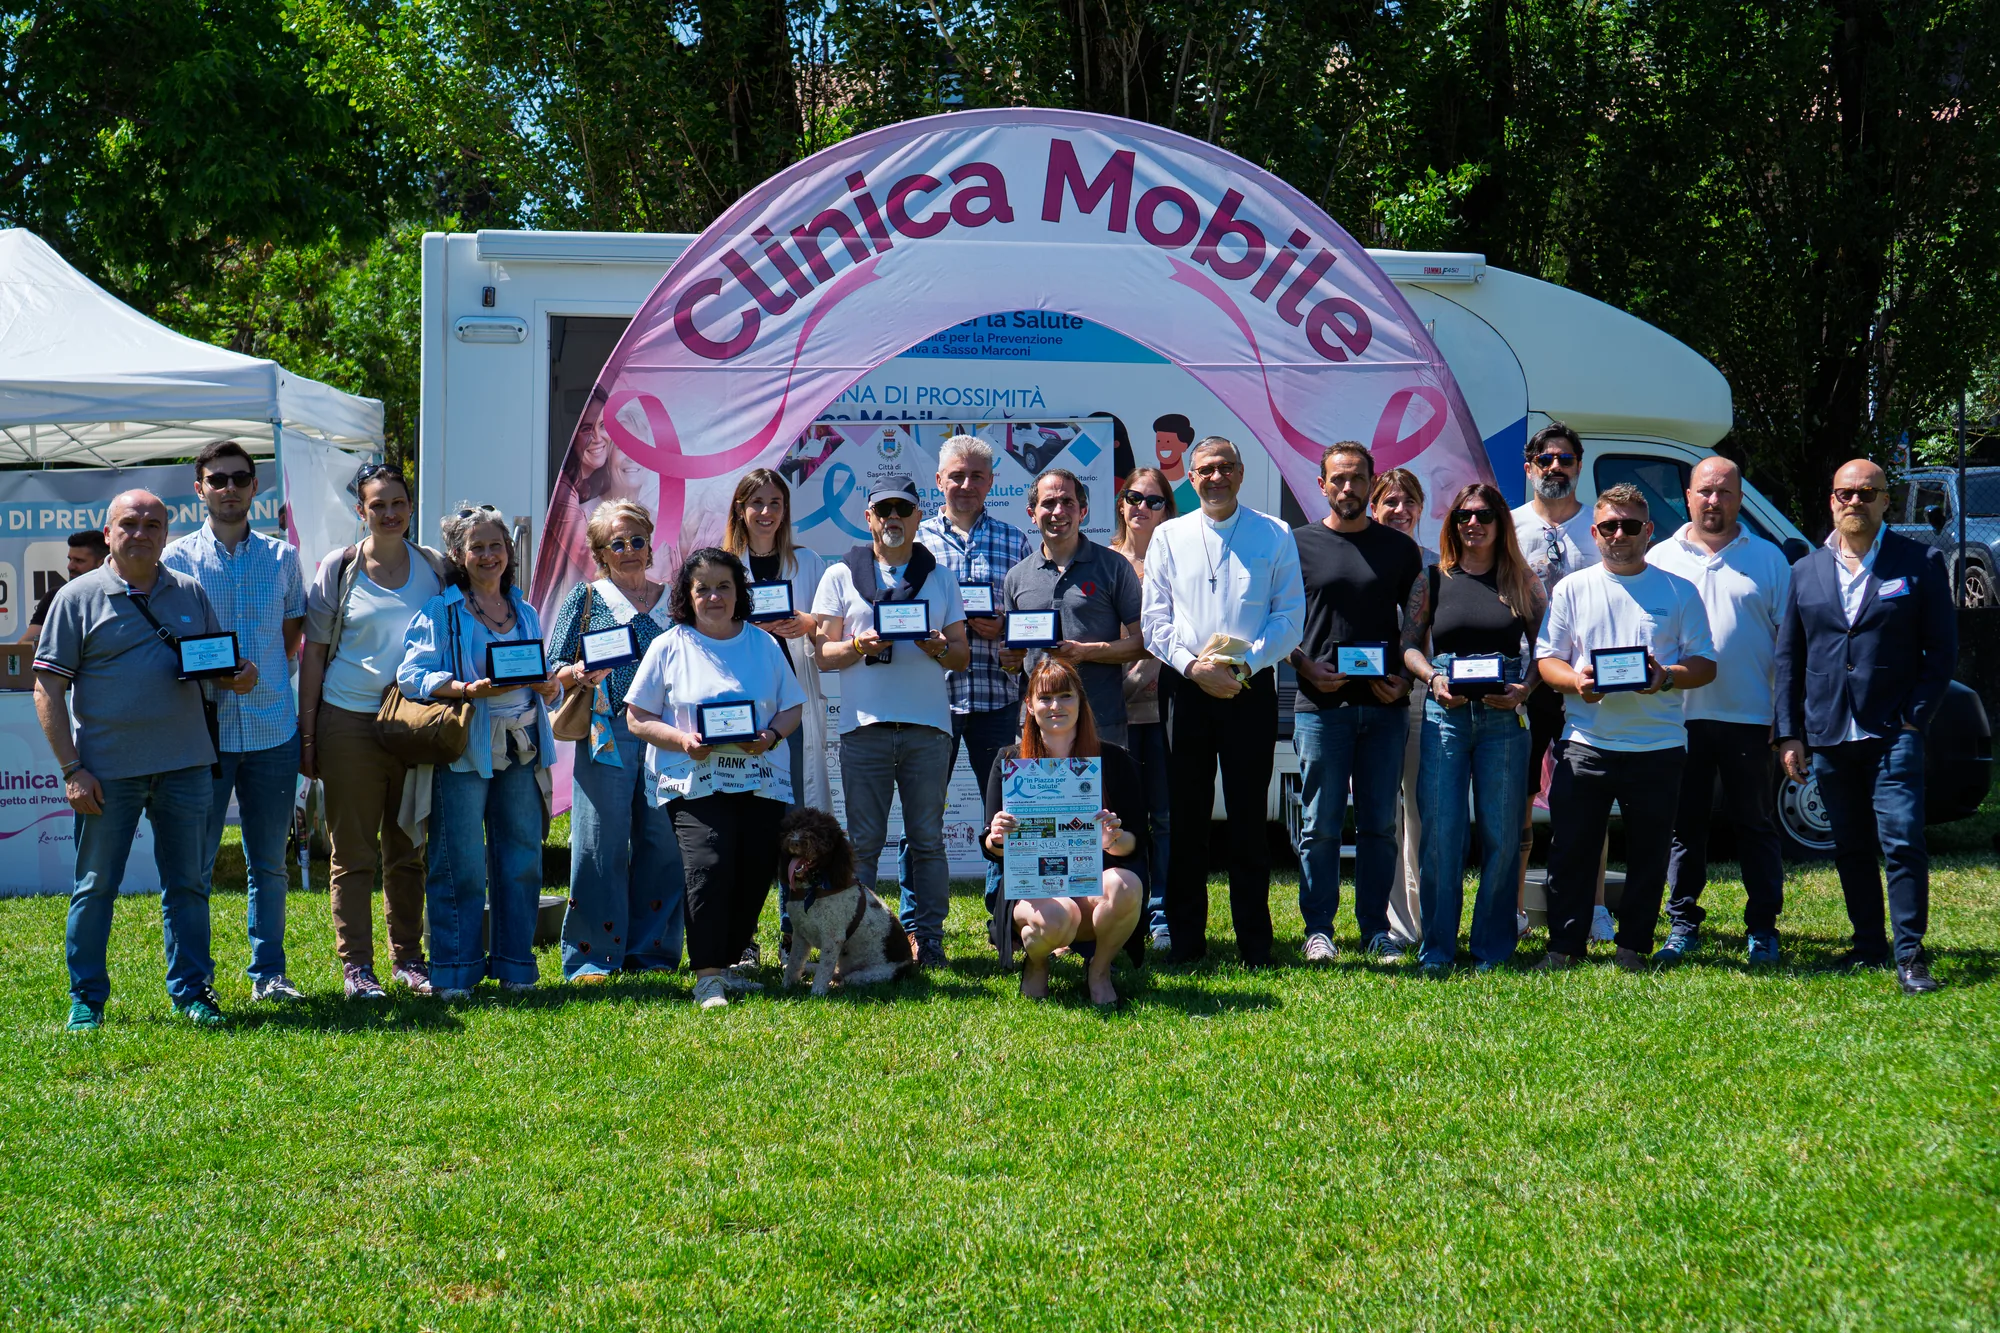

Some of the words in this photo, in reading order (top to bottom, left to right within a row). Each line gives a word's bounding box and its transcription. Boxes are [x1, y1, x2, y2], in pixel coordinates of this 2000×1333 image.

[674, 162, 1014, 360] Clinica
[1041, 138, 1373, 362] Mobile
[1012, 311, 1083, 329] Salute
[949, 333, 971, 344] per
[973, 332, 984, 342] la
[987, 333, 1063, 345] Prevenzione
[931, 345, 939, 354] a
[942, 344, 978, 355] Sasso
[981, 345, 1031, 356] Marconi
[885, 385, 908, 405] DI
[916, 385, 1046, 408] PROSSIMITÀ
[986, 483, 1031, 497] alute”
[9, 509, 32, 530] DI
[718, 757, 747, 769] RANK
[0, 771, 58, 790] linica
[722, 781, 744, 789] WANTED
[29, 796, 39, 805] di
